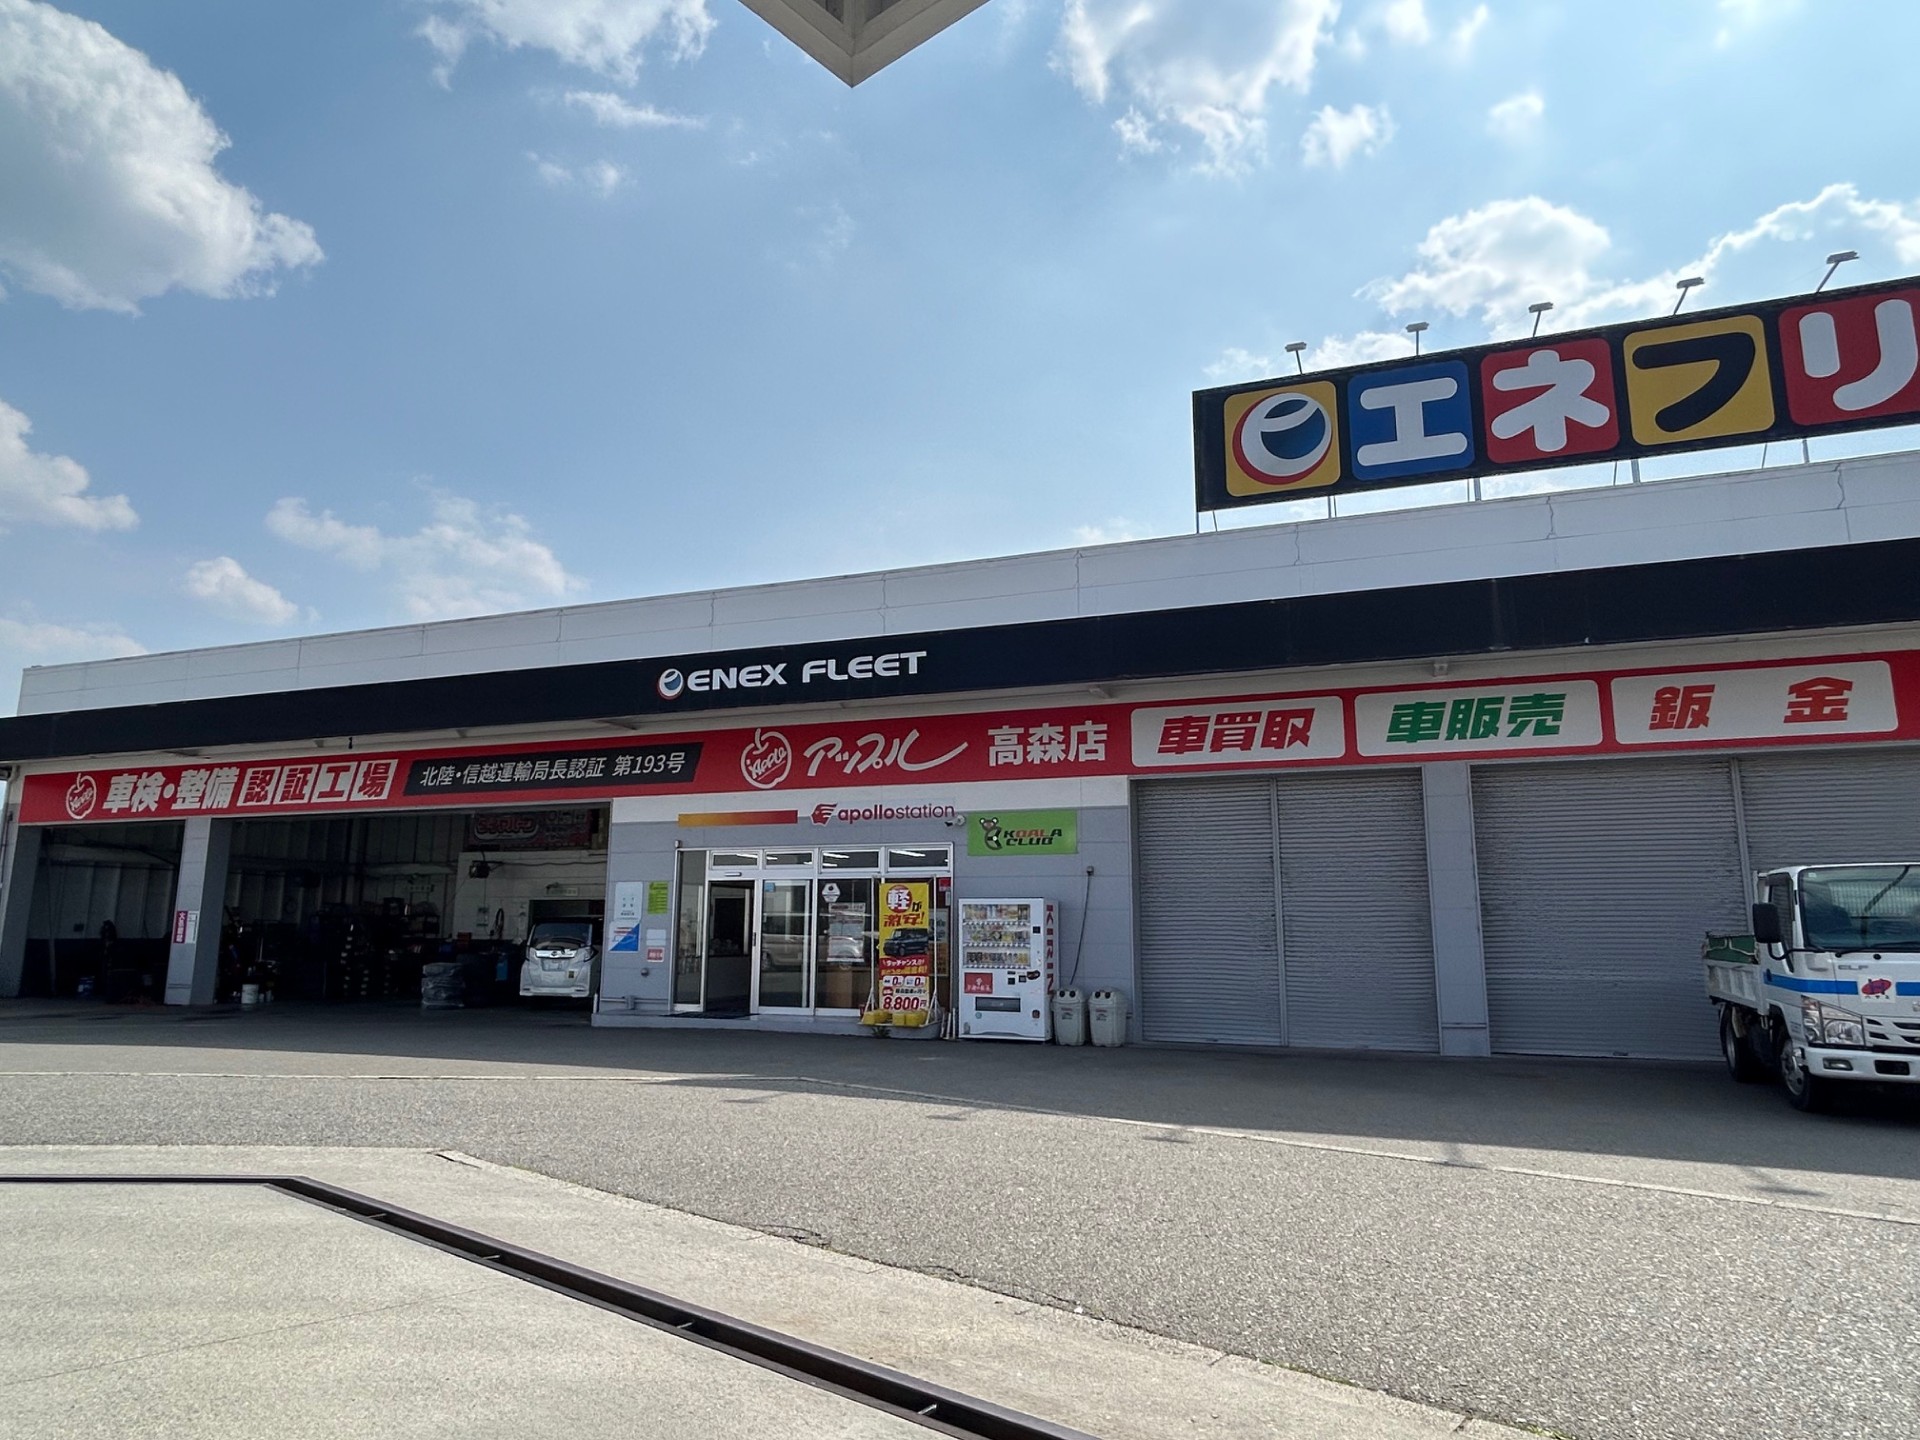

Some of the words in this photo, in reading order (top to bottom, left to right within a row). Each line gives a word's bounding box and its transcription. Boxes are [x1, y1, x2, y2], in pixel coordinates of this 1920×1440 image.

[1356, 299, 1919, 467] エネフリ
[687, 663, 788, 691] ENEX
[802, 651, 927, 683] FLEET
[1157, 708, 1316, 754] 車買取
[1386, 693, 1567, 744] 車販売
[804, 729, 969, 777] アップル
[988, 720, 1108, 767] 高森店
[420, 757, 606, 787] 北陸・信越運輸局長認証
[612, 752, 686, 777] 第193号
[838, 803, 955, 826] apollostation
[1004, 828, 1063, 839] KOALA
[1006, 837, 1053, 847] CLUB
